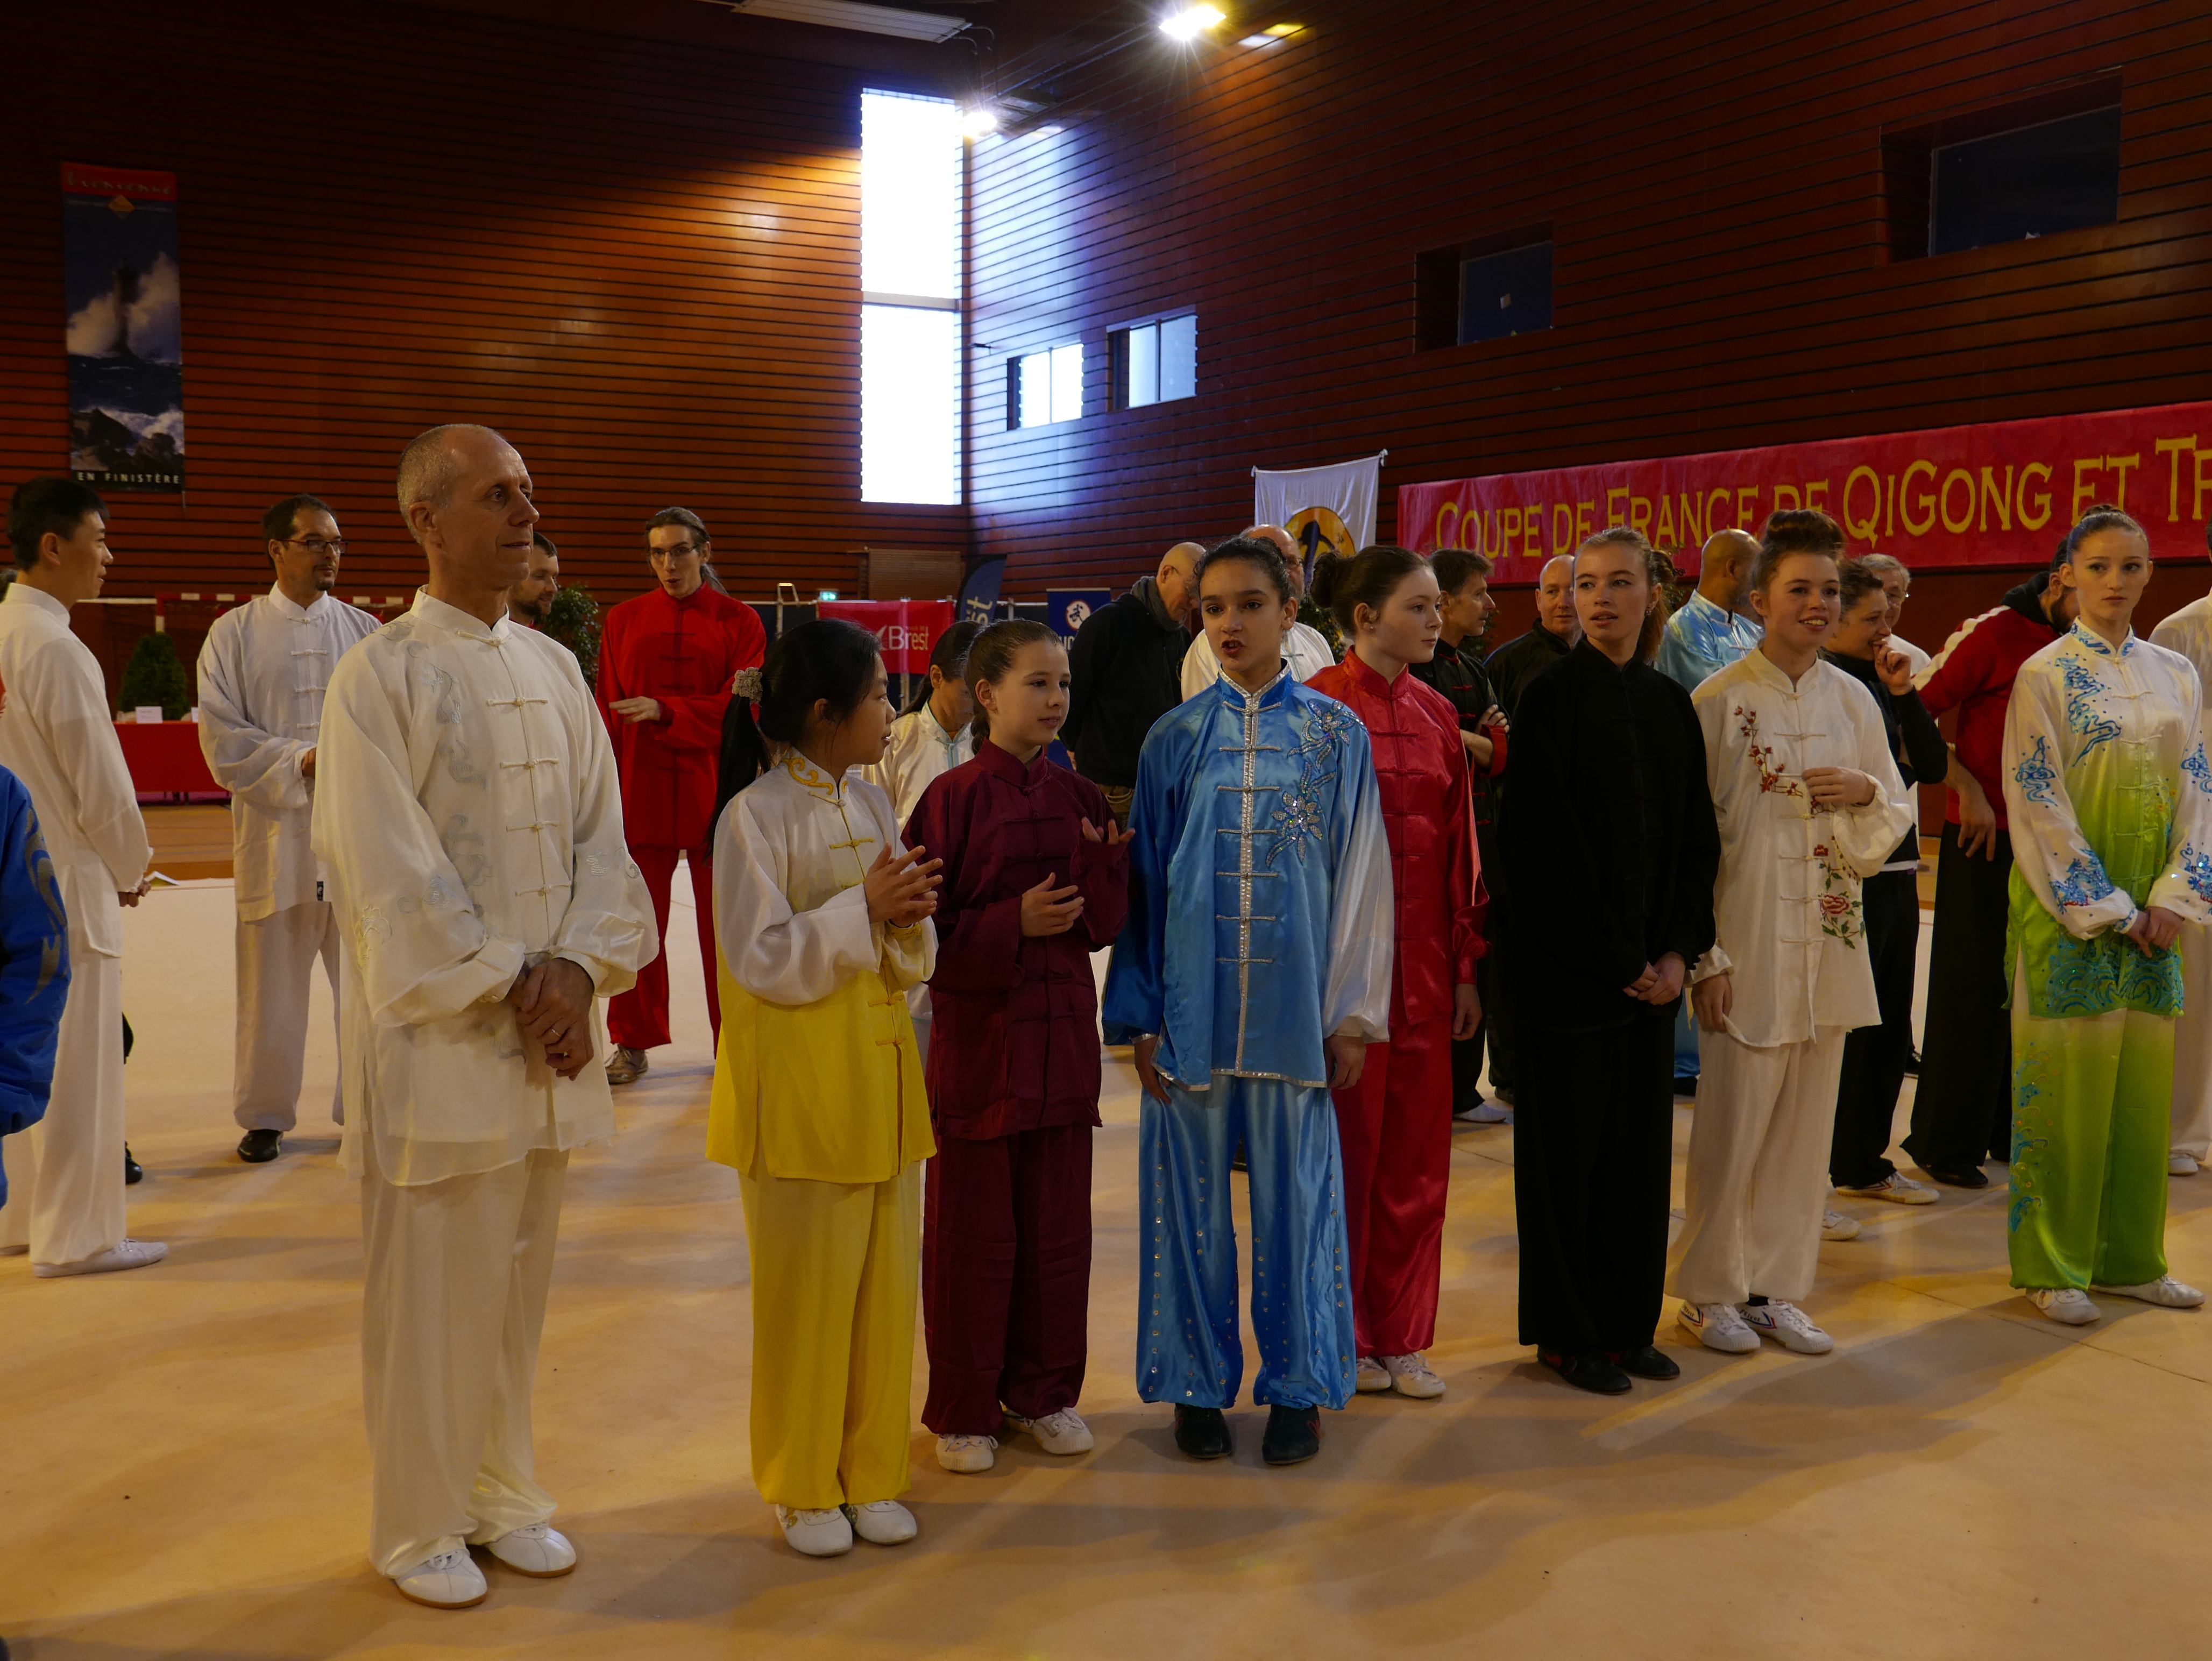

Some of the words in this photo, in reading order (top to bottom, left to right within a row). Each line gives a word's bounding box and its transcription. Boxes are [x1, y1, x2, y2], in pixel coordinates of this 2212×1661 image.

[77, 471, 95, 481] EN
[104, 472, 180, 485] FINISTÈRE
[1436, 500, 1542, 559] COUPE
[1552, 499, 1595, 555] DE
[1606, 484, 1759, 549] FRANCE
[1843, 458, 2053, 549] QIGONG
[2071, 451, 2140, 527] ET
[888, 625, 930, 651] Brest
